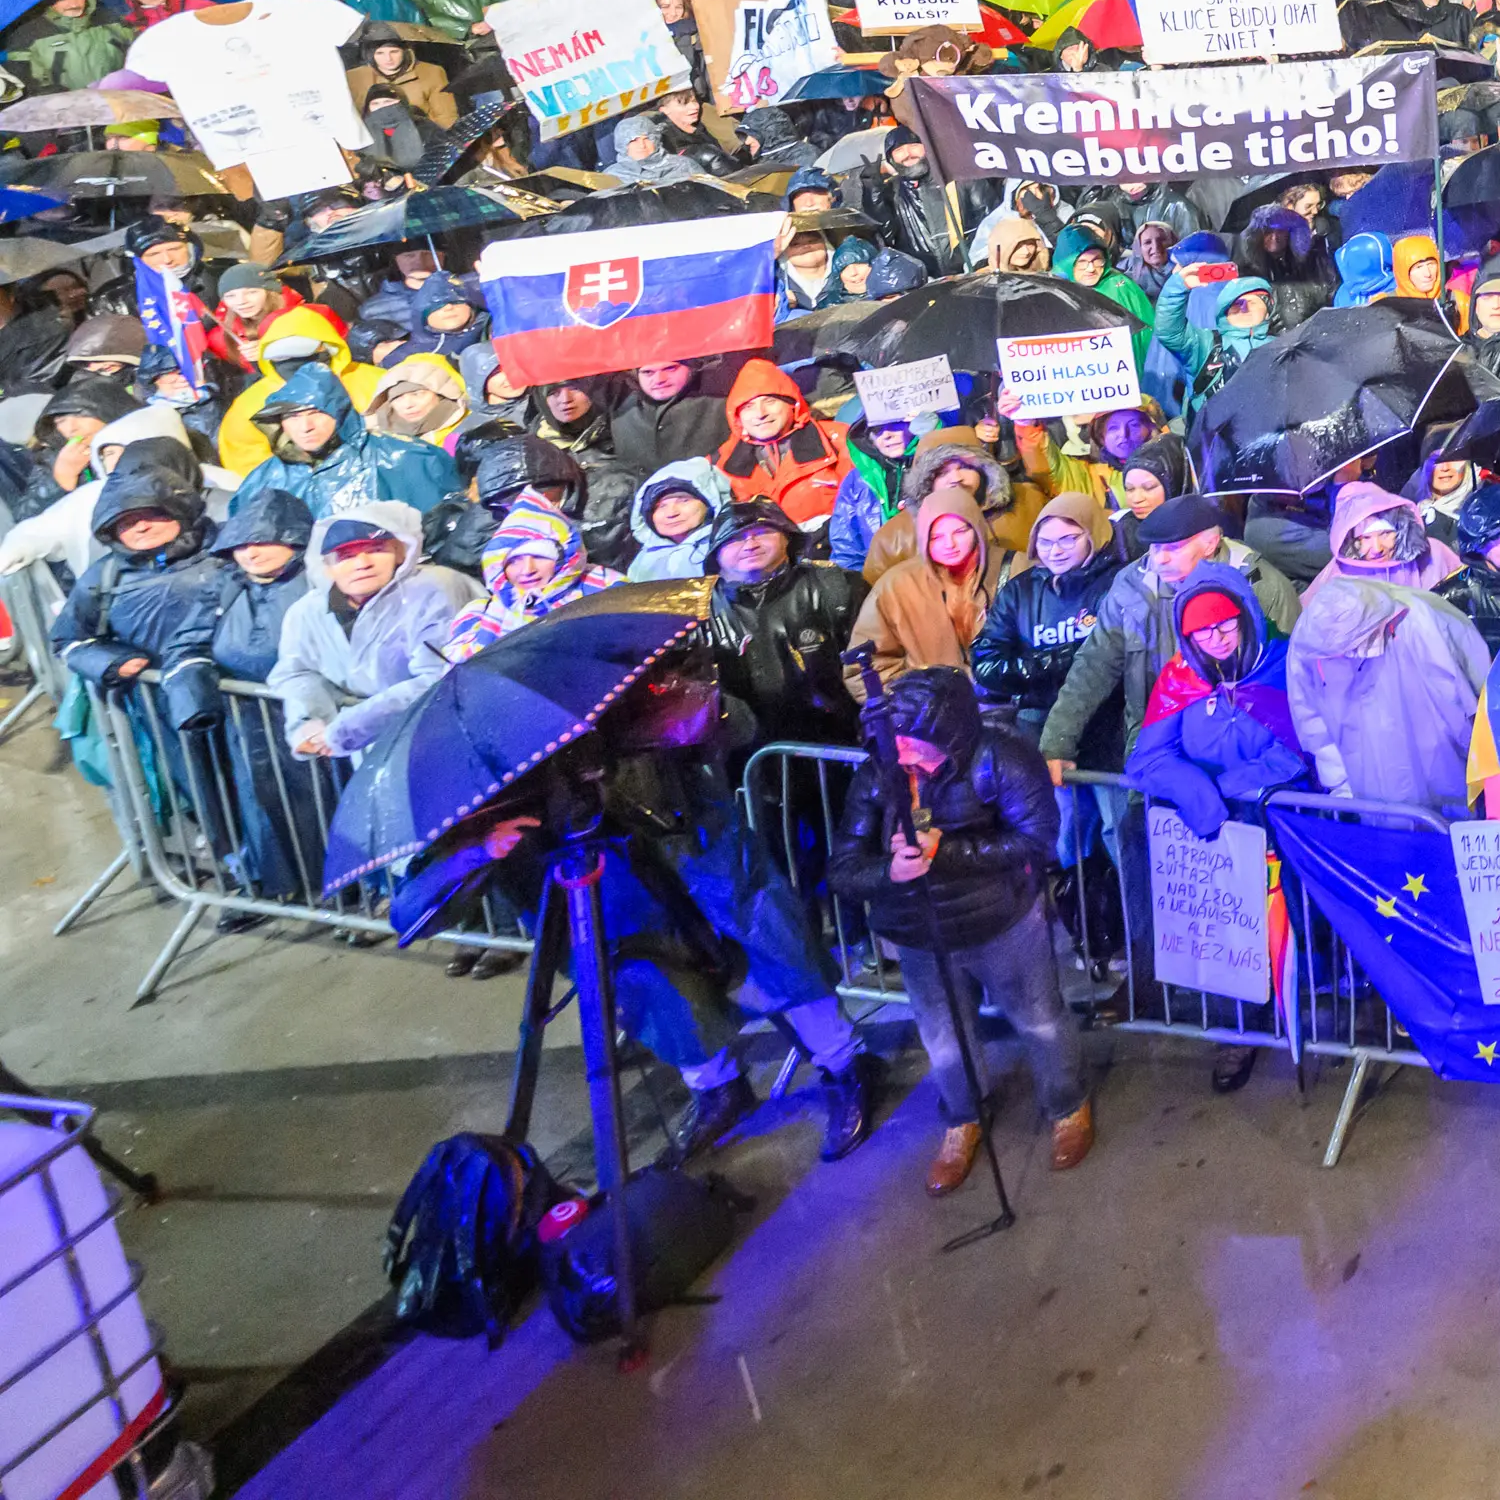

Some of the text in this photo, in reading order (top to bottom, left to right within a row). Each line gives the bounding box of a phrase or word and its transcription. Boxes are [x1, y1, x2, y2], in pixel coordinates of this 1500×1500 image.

[1204, 29, 1259, 52] ZNIET
[508, 29, 606, 84] NEMÁM
[1346, 79, 1398, 125] je
[973, 113, 1401, 177] a nebude ticho!
[1088, 335, 1113, 350] SA
[1011, 359, 1130, 383] BOJÍ HLASU A
[1080, 383, 1131, 402] ĽUDU
[1166, 843, 1234, 872] A PRAVDA
[1166, 882, 1197, 898] NAD
[1156, 895, 1165, 910] A
[1187, 921, 1216, 939] ALE
[1160, 933, 1225, 962] NIE BEZ
